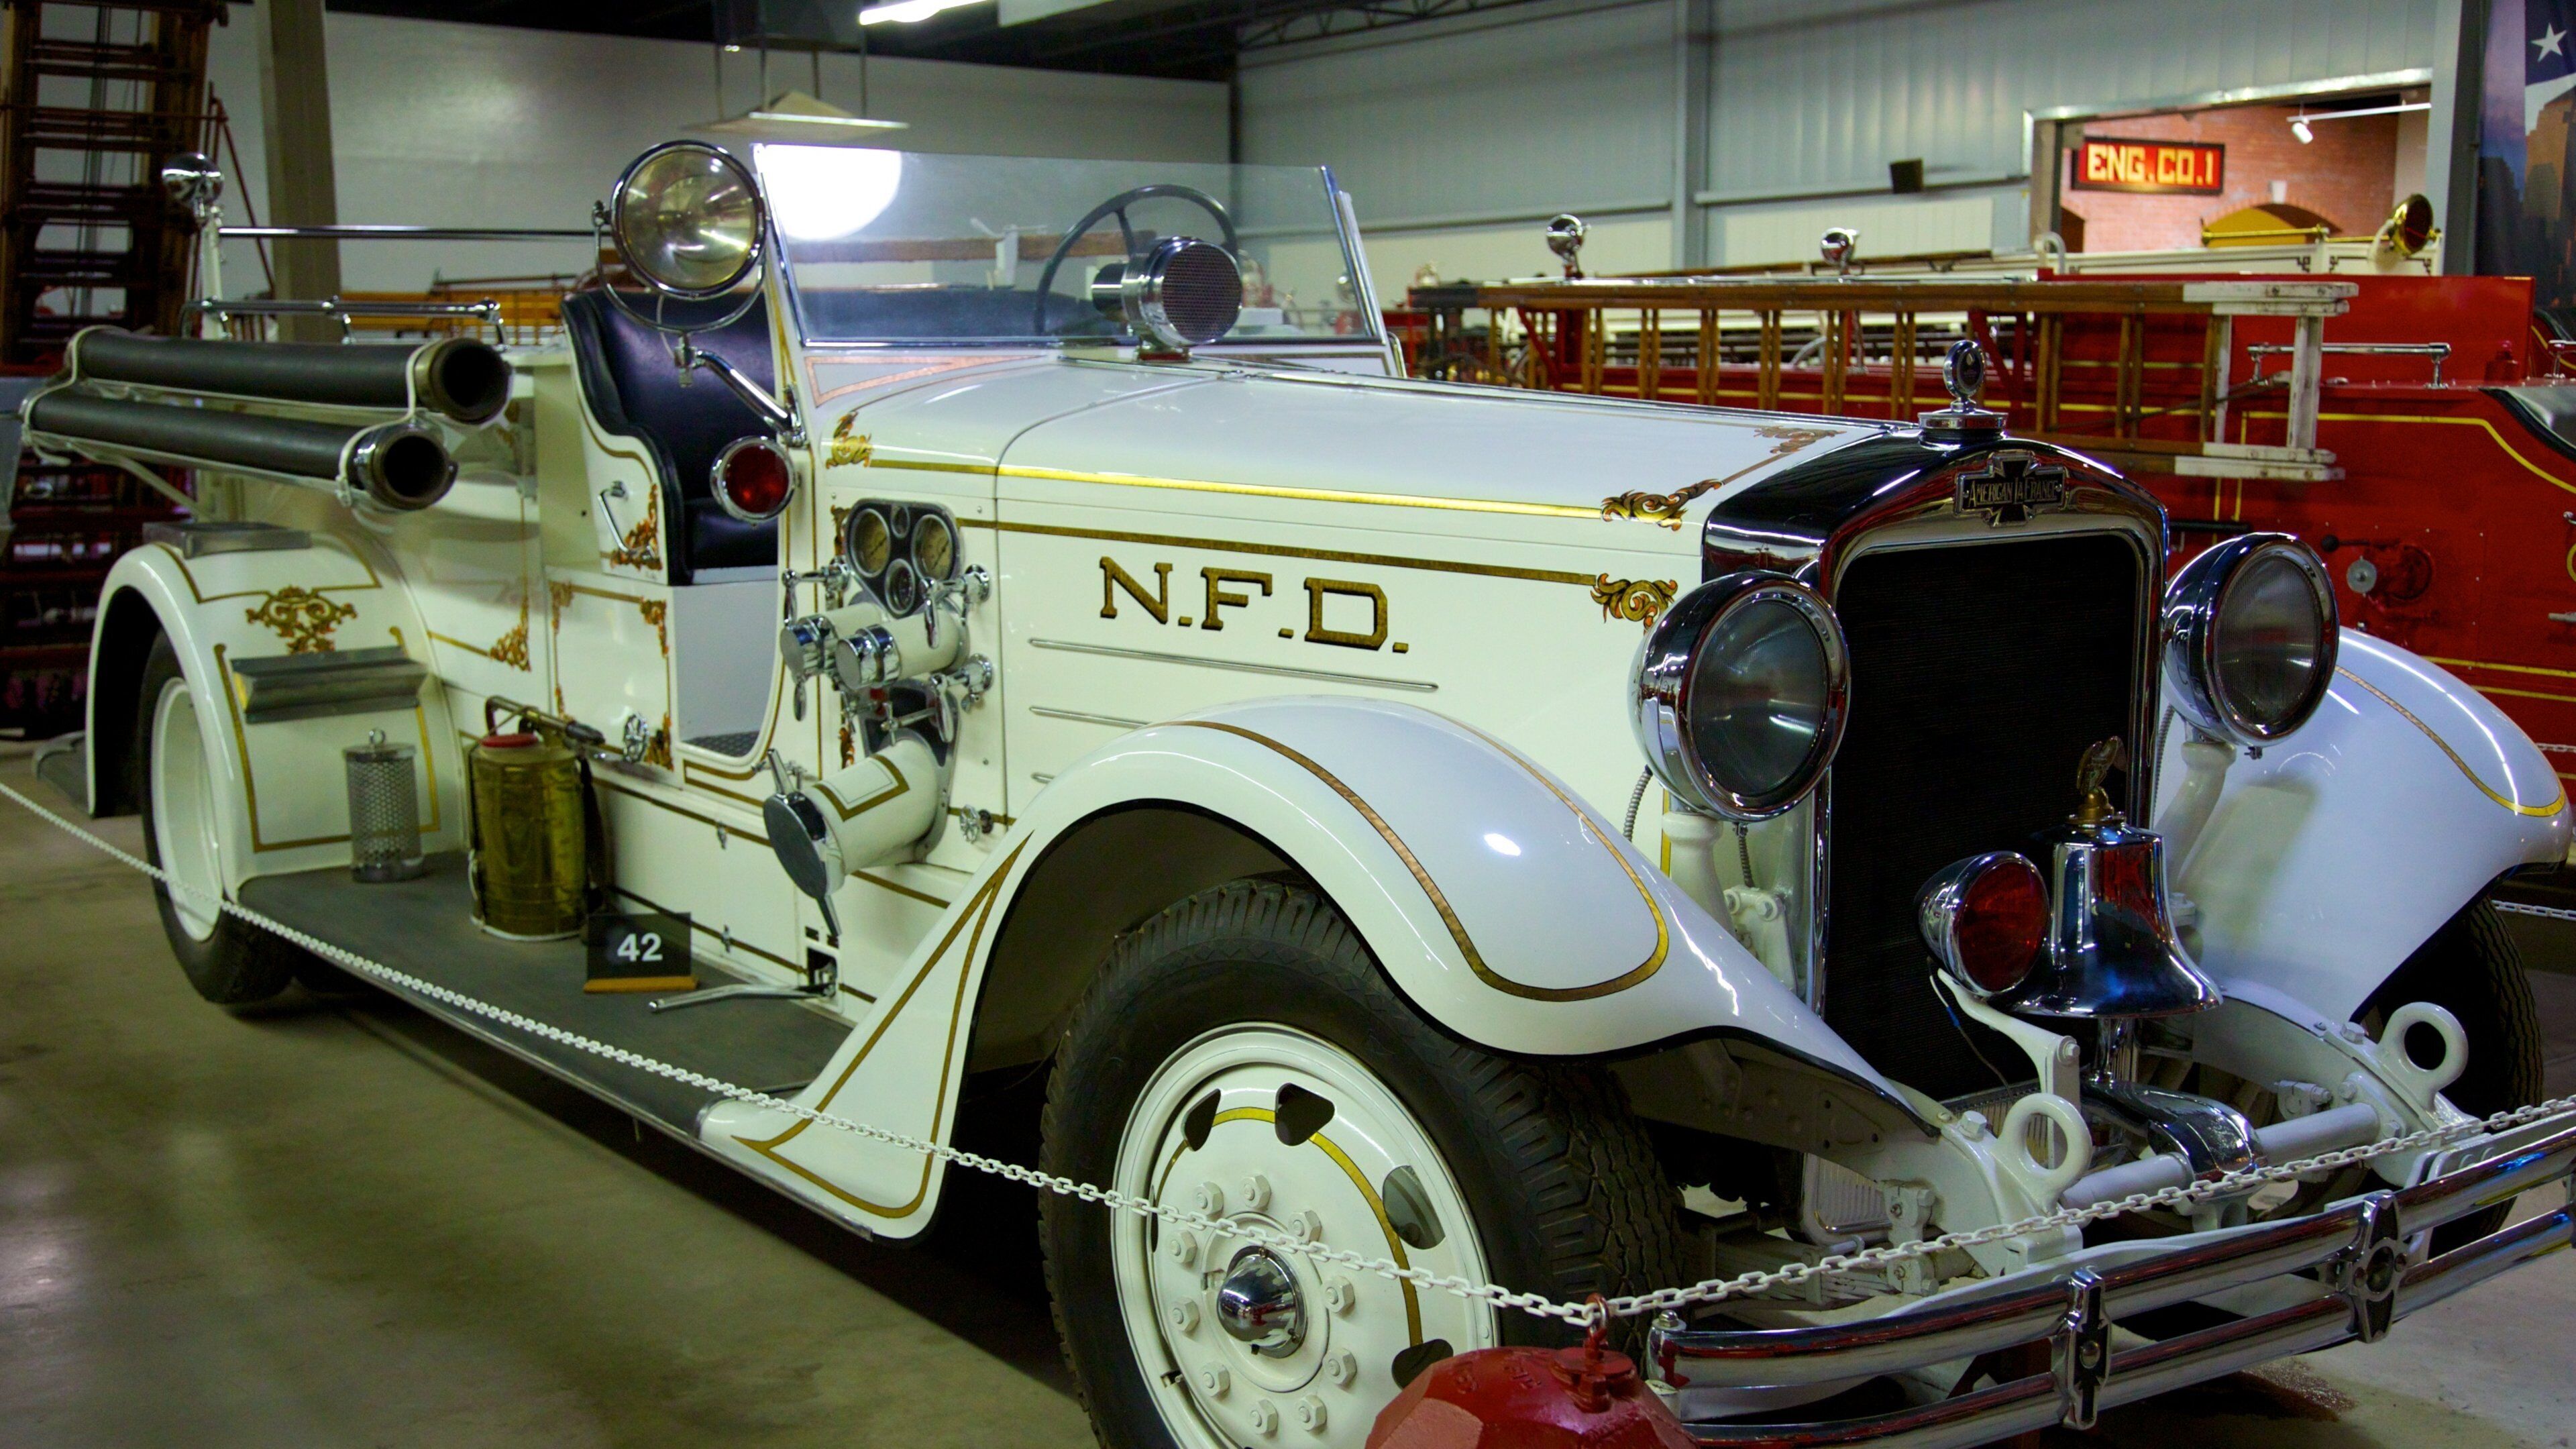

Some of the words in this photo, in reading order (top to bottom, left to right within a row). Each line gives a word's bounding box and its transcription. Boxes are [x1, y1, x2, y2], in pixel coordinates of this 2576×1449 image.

[1968, 480, 2012, 508] AMERICAN
[1099, 556, 1409, 653] N.F.D.
[617, 932, 663, 962] 42
